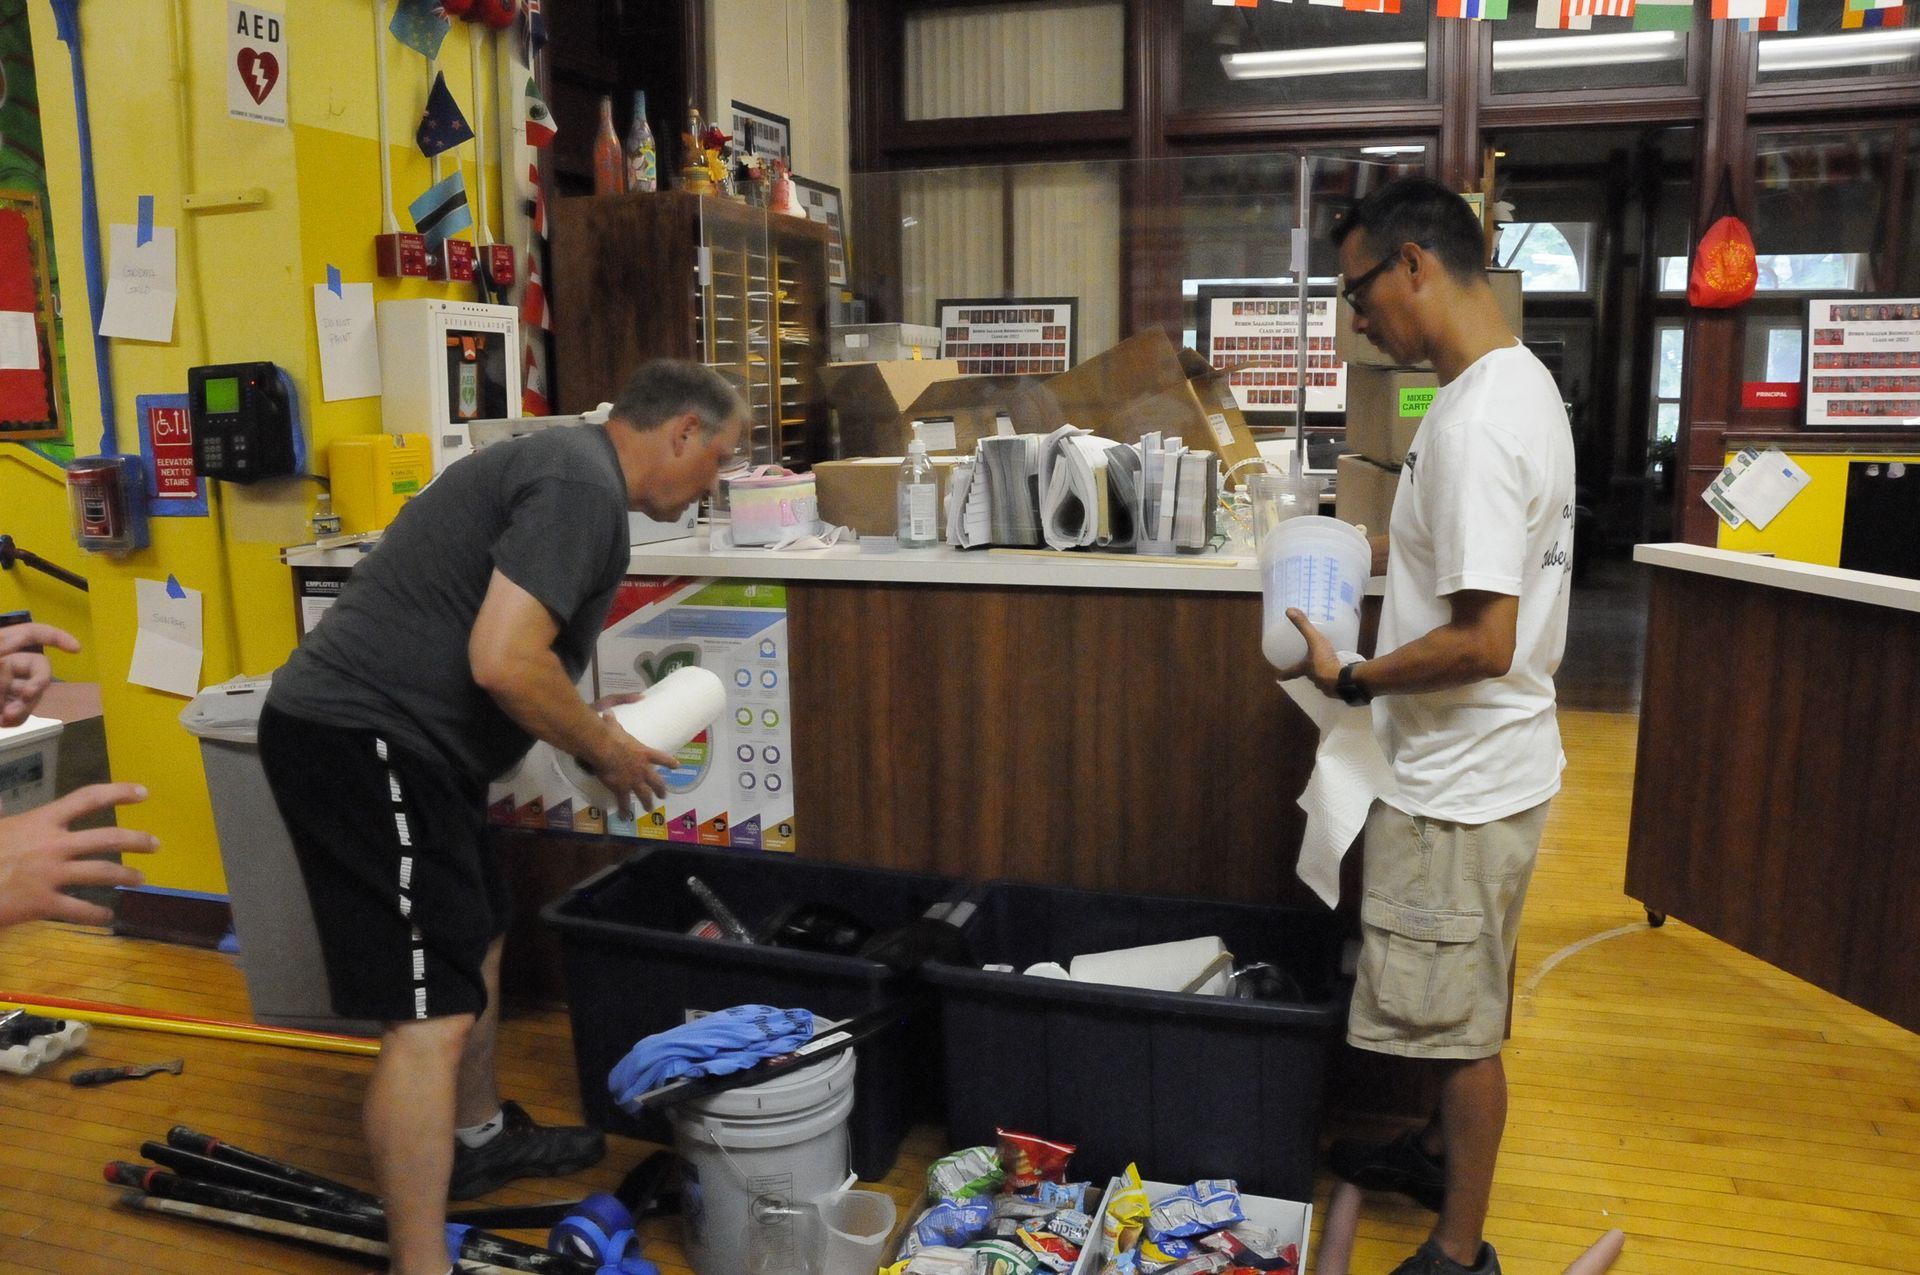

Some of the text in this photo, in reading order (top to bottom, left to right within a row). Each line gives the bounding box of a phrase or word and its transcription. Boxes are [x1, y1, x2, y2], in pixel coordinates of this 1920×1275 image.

[237, 10, 280, 43] AED
[444, 318, 506, 330] DEFIBRILLATOR
[1406, 393, 1434, 402] MIXED
[1402, 402, 1431, 411] CARTO
[157, 458, 194, 467] ELEVATOR
[161, 468, 191, 477] NEXT TO
[164, 478, 190, 487] STAIRS
[305, 580, 339, 588] EMPLOYEE
